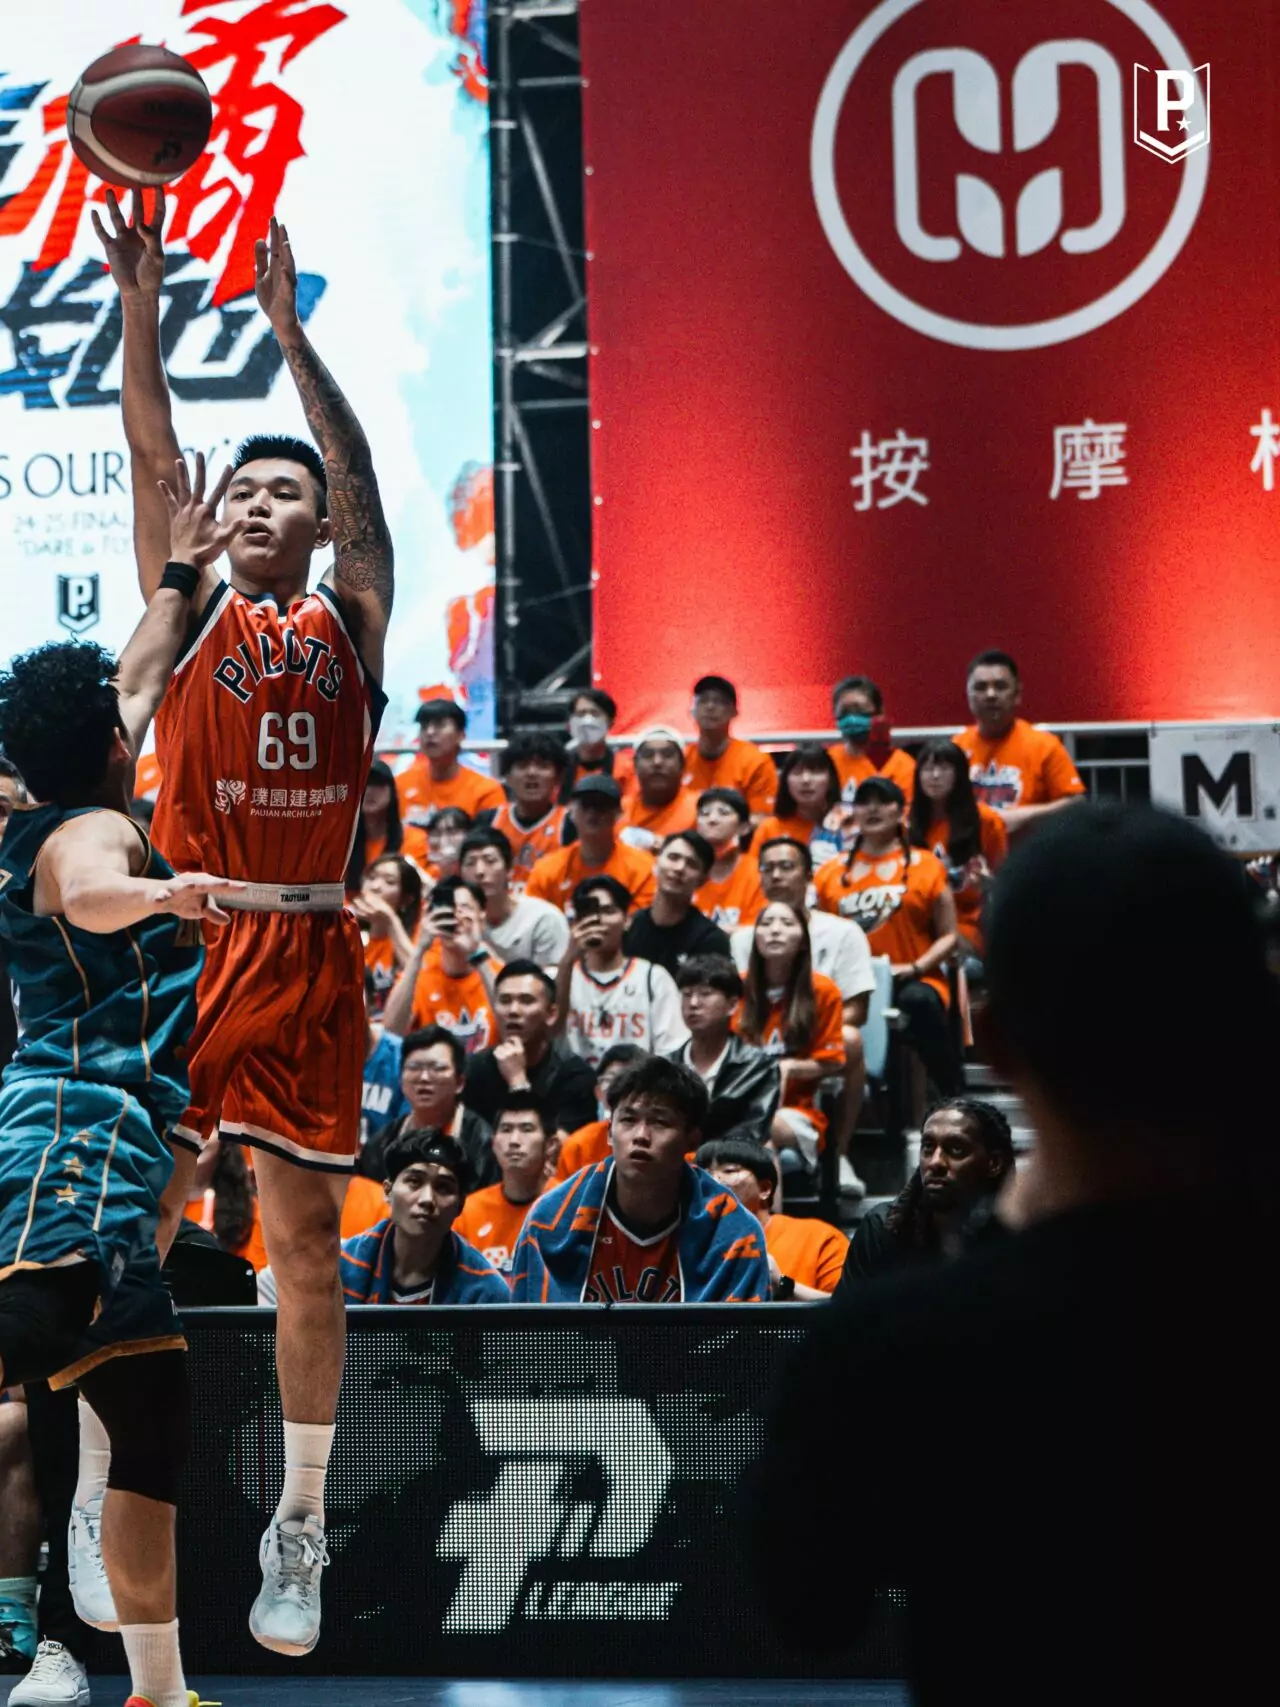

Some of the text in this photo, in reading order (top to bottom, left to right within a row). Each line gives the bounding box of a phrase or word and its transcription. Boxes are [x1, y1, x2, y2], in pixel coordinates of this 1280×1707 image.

[24, 450, 127, 499] OUR
[213, 627, 344, 704] PILOTS
[257, 711, 318, 771] 69
[250, 783, 349, 808] 璞園建築團隊
[1181, 752, 1253, 817] M
[280, 893, 310, 902] TAOYUAN
